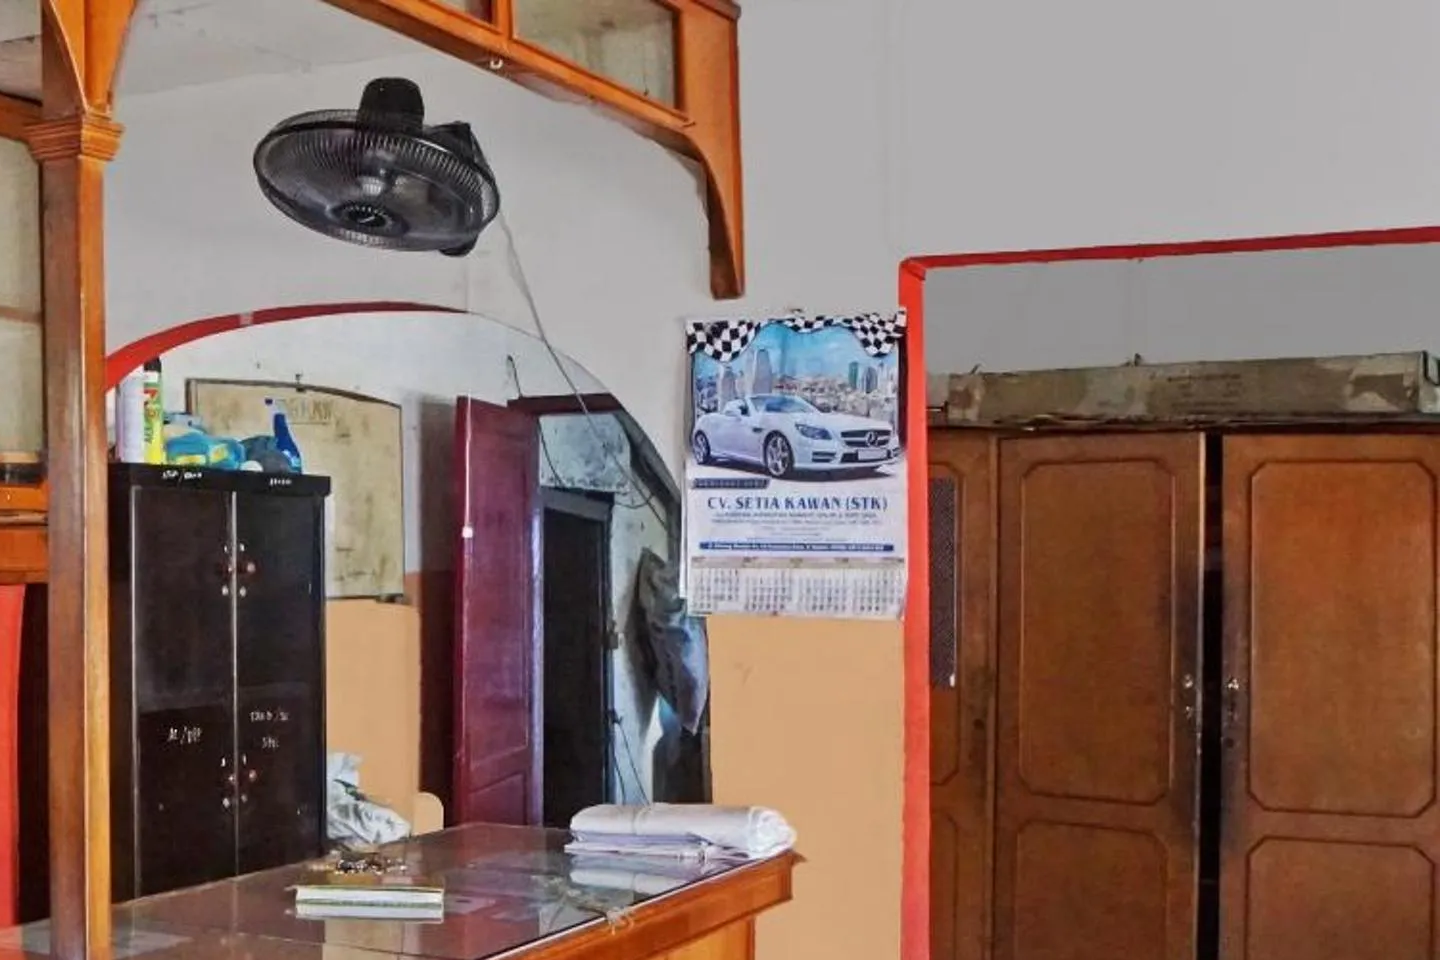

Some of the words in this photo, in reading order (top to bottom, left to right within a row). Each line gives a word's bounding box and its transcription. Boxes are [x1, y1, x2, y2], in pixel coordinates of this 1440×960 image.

[707, 496, 731, 509] CV.
[735, 496, 780, 510] SETIA
[784, 496, 841, 510] KAWAN
[845, 496, 888, 512] (STK)
